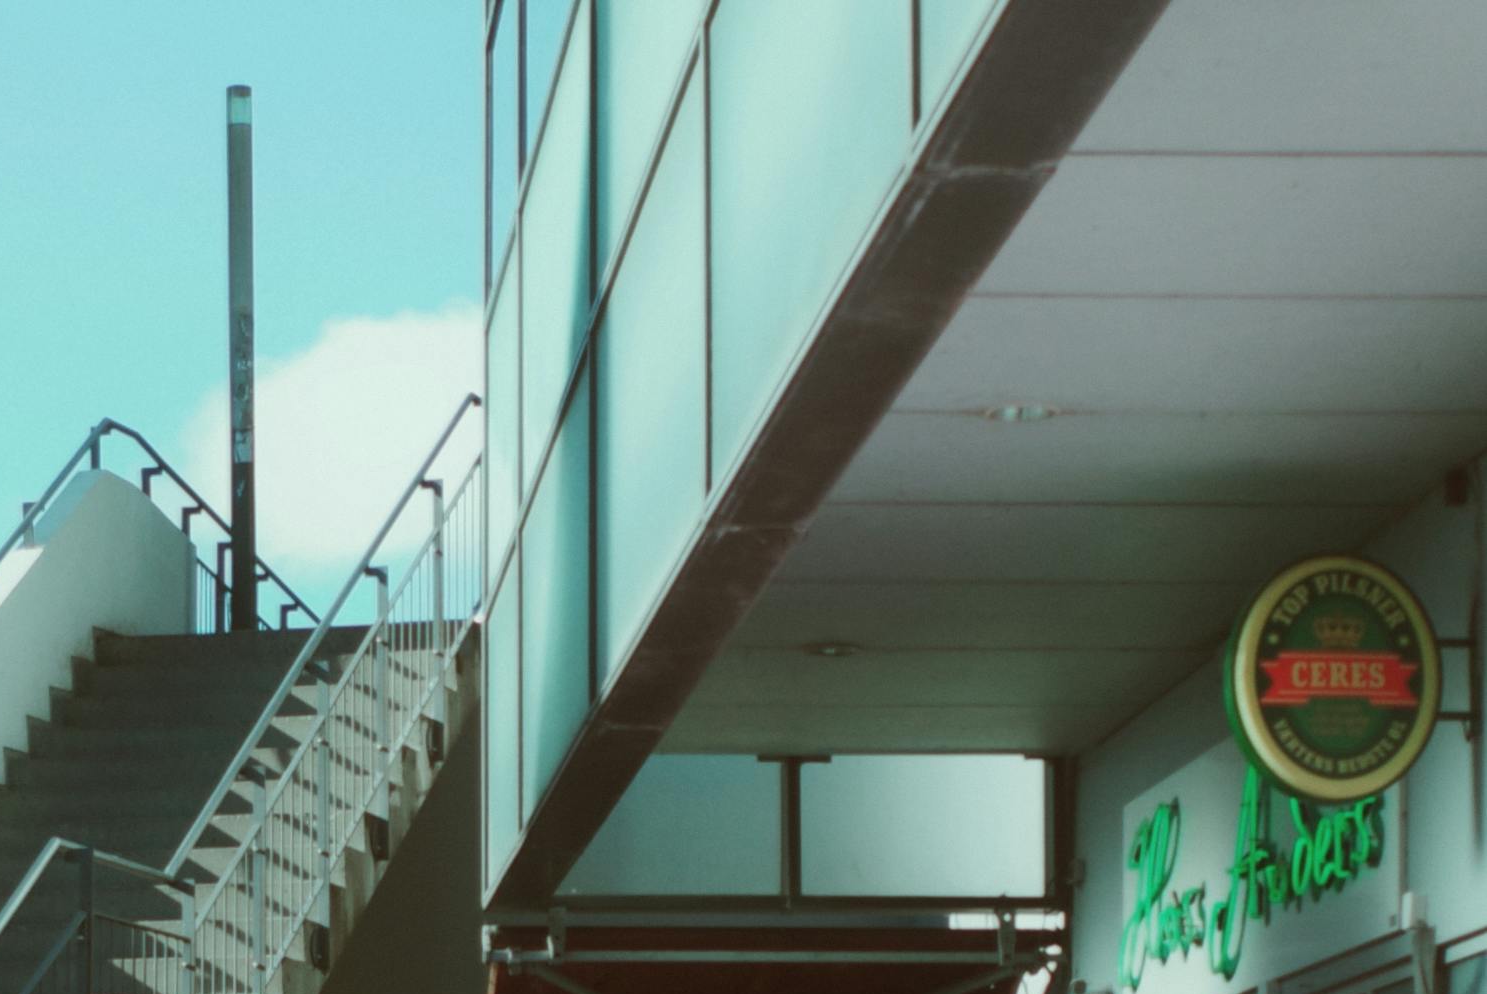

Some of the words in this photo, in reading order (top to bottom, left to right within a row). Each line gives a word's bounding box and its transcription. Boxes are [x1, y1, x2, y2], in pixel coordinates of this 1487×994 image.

[1272, 584, 1310, 626] TOP
[1314, 573, 1406, 629] PILSNER
[1291, 661, 1386, 689] CERES
